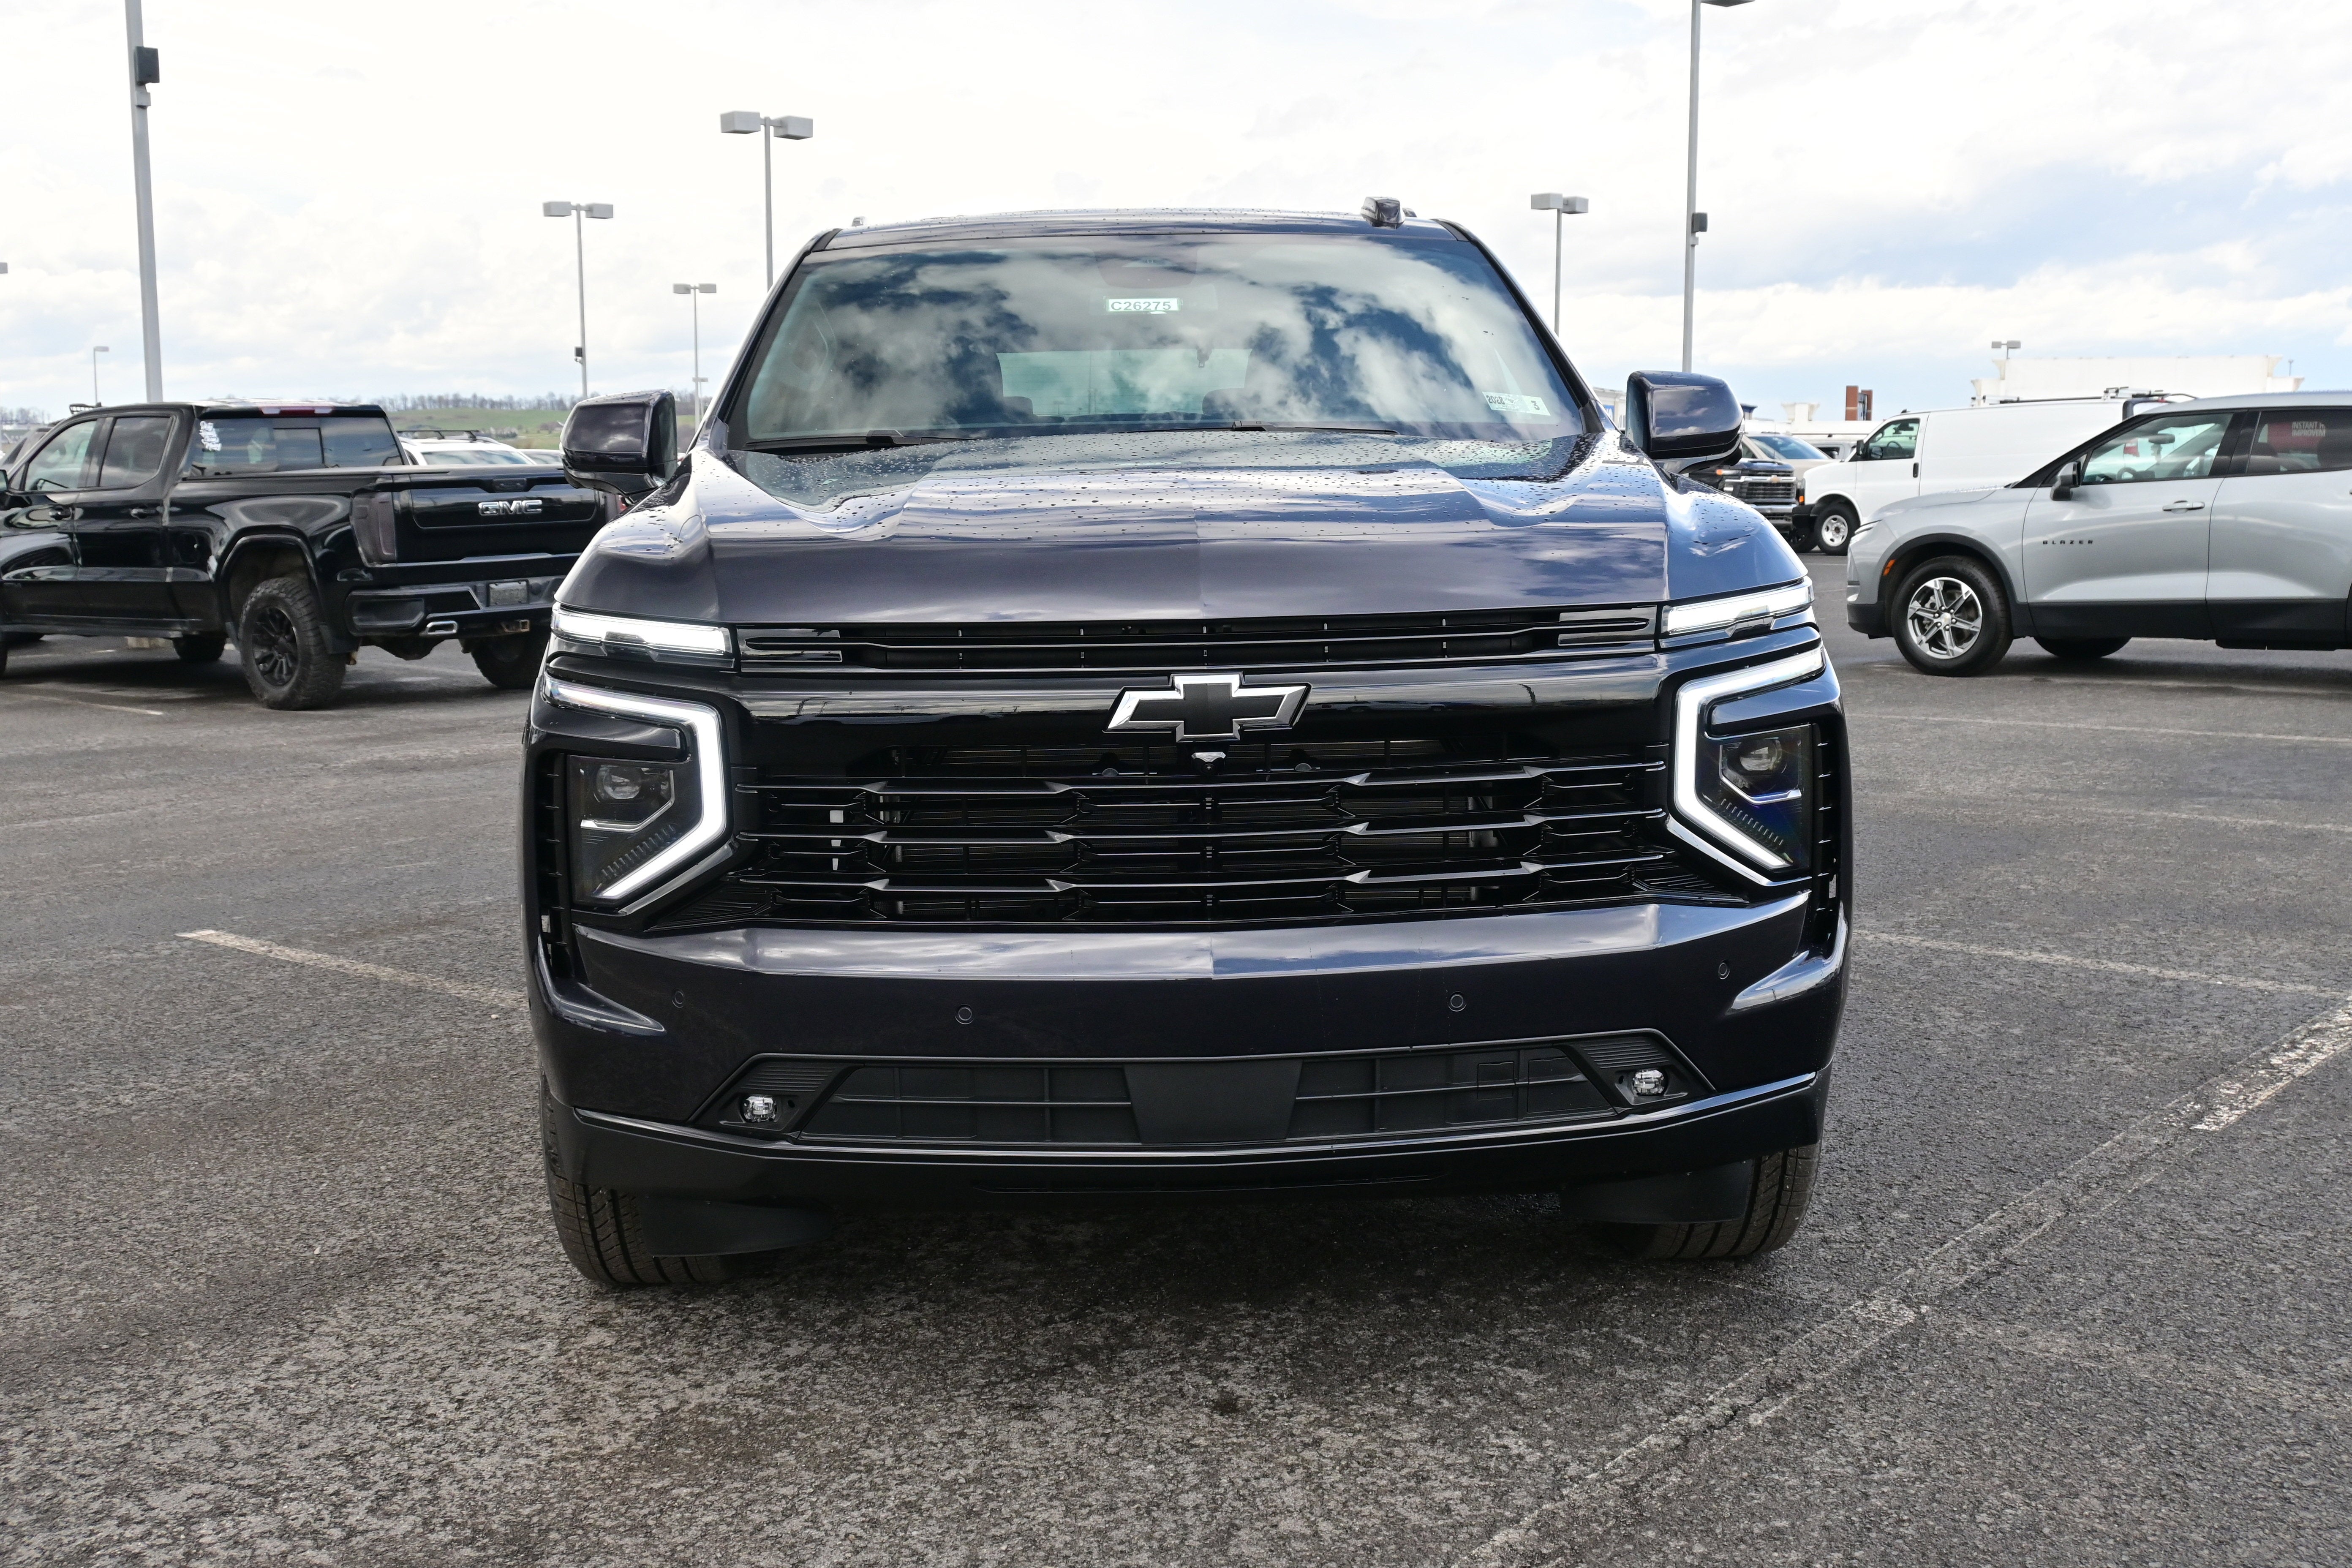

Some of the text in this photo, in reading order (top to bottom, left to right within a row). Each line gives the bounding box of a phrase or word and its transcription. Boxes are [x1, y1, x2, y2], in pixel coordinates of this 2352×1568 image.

[1111, 301, 1171, 310] C26275
[1486, 395, 1505, 405] 2028
[1531, 400, 1540, 410] 3
[2292, 421, 2318, 429] INSTANT
[478, 499, 543, 516] GMC
